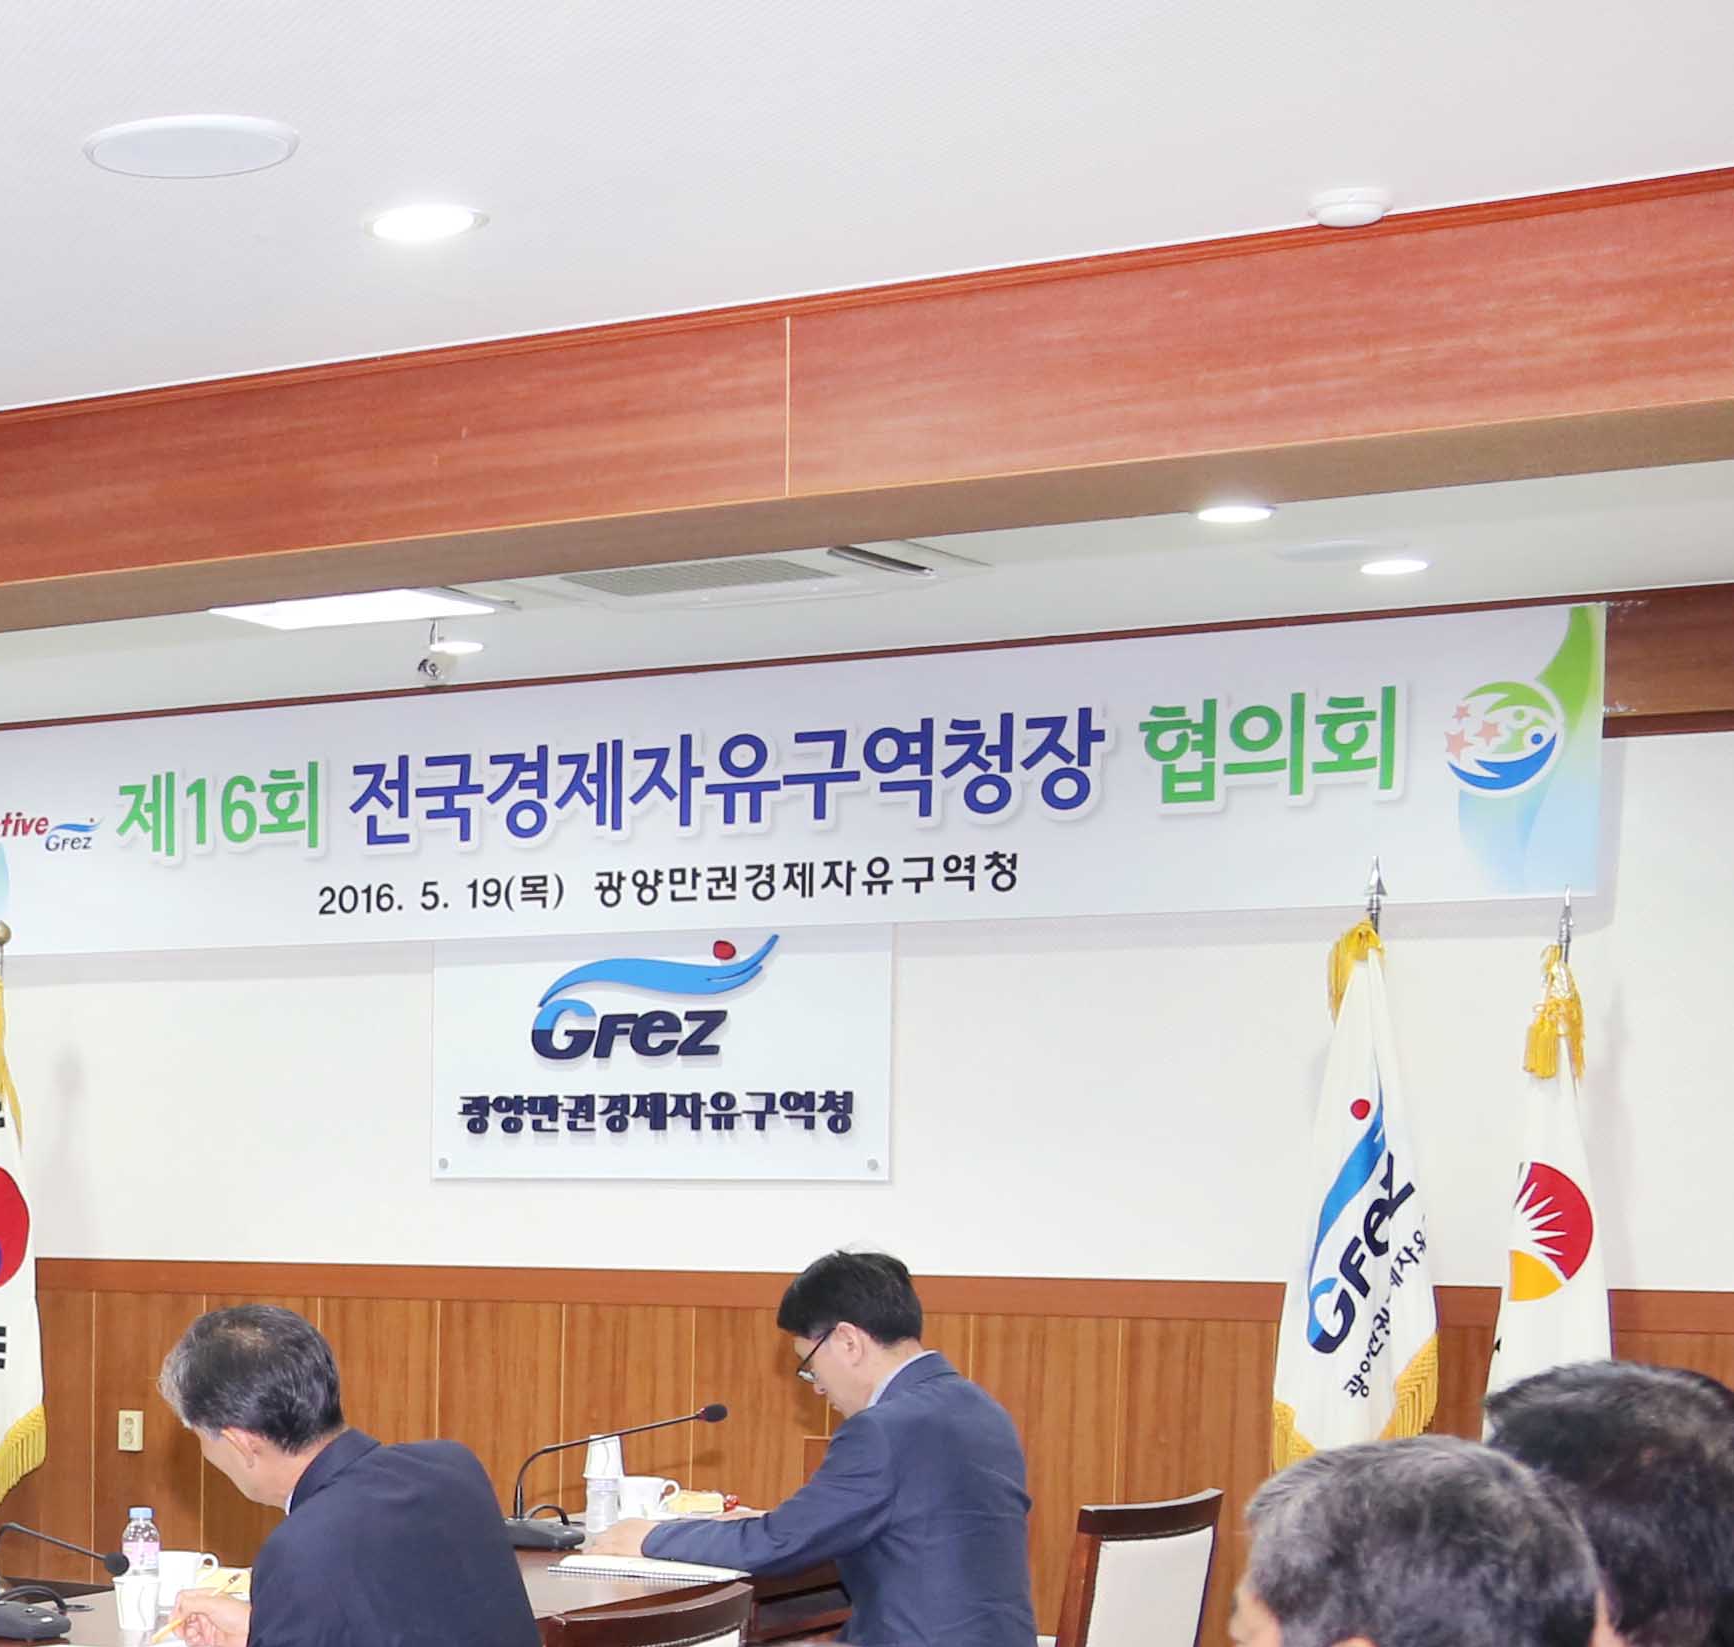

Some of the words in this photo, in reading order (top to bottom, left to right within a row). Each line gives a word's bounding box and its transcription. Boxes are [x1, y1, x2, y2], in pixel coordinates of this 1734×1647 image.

[117, 761, 319, 856] 제16회
[349, 706, 1106, 848] 전국경제자유구역청장
[1140, 685, 1397, 804] 협의회
[318, 882, 404, 916] 2016.
[420, 880, 450, 911] 5.
[467, 873, 566, 911] 19(목)
[593, 850, 1019, 909] 광양만권경제자유구역청
[457, 1090, 855, 1135] 광양만권경제자유구역청
